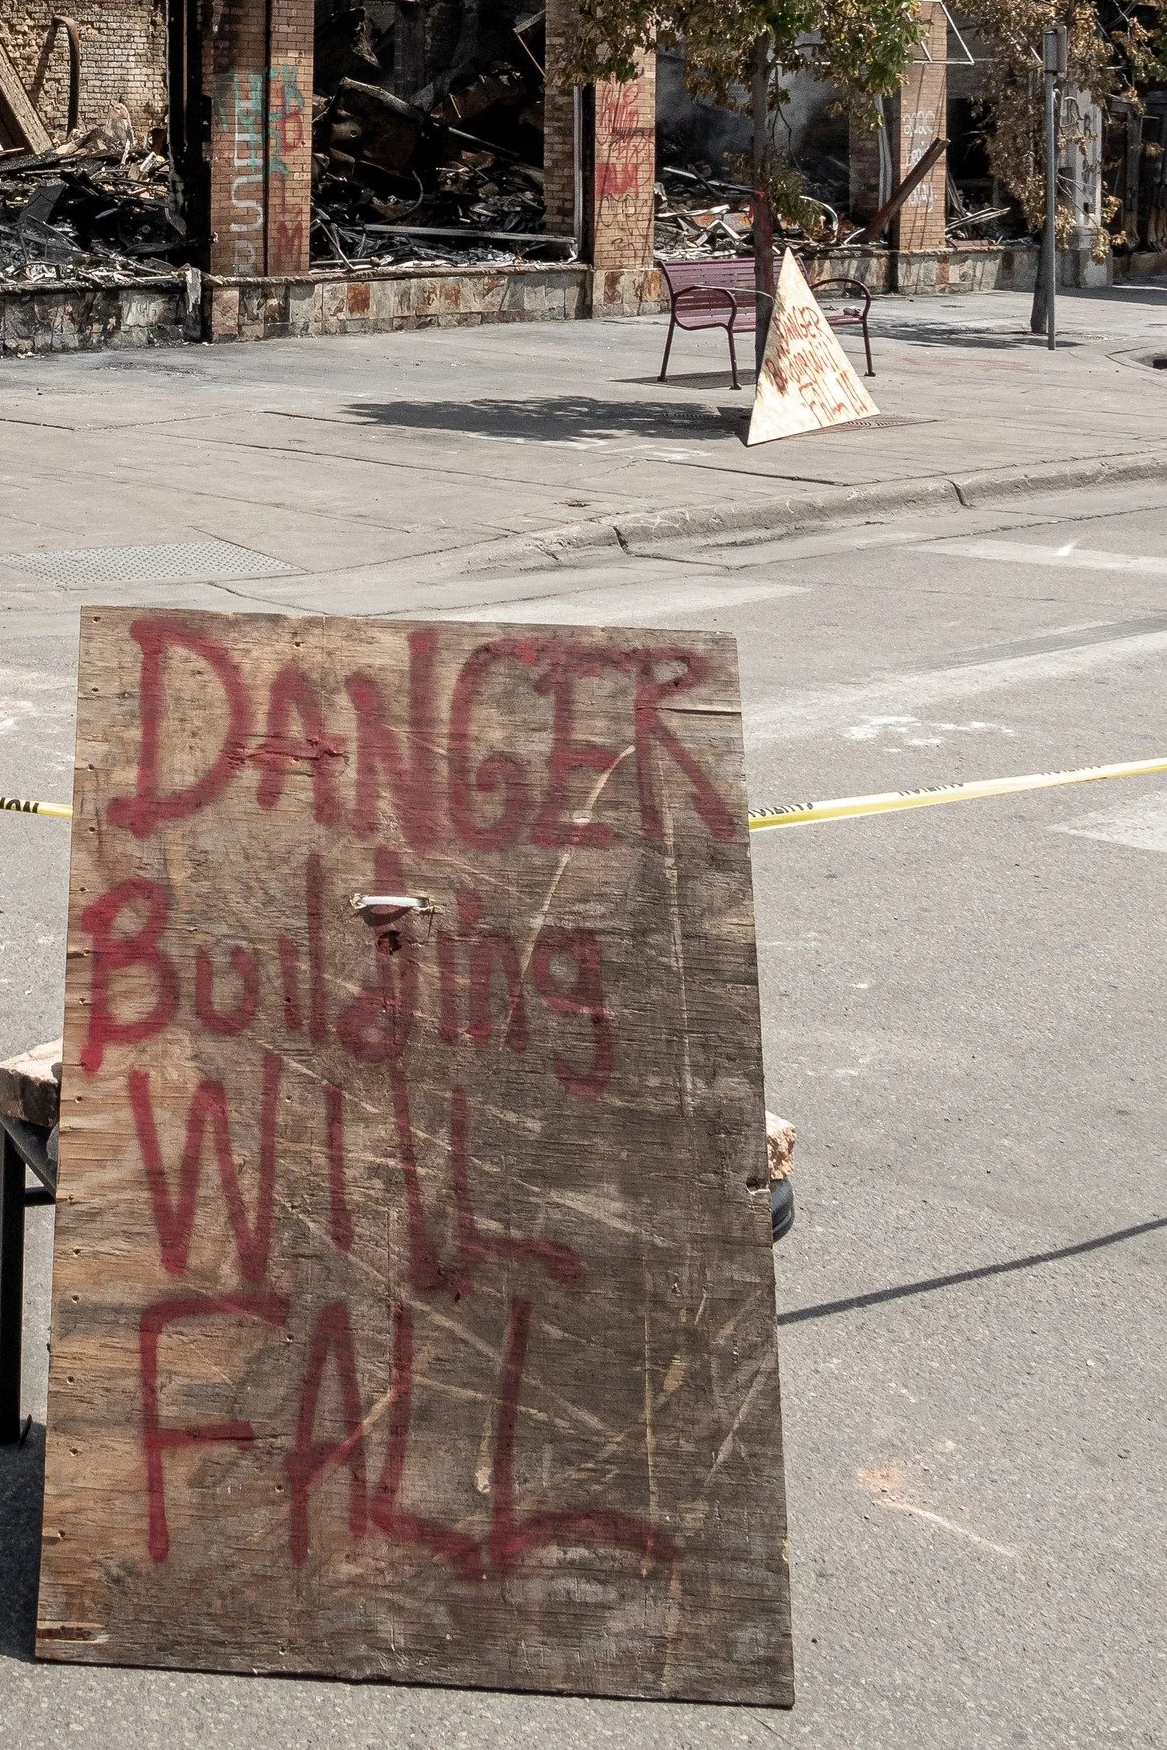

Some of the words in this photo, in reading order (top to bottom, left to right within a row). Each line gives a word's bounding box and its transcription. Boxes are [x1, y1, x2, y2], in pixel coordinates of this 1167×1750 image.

[106, 617, 737, 850] DANGER
[81, 850, 615, 1098] Building
[132, 1055, 581, 1300] WILL
[139, 1292, 682, 1582] FALL
